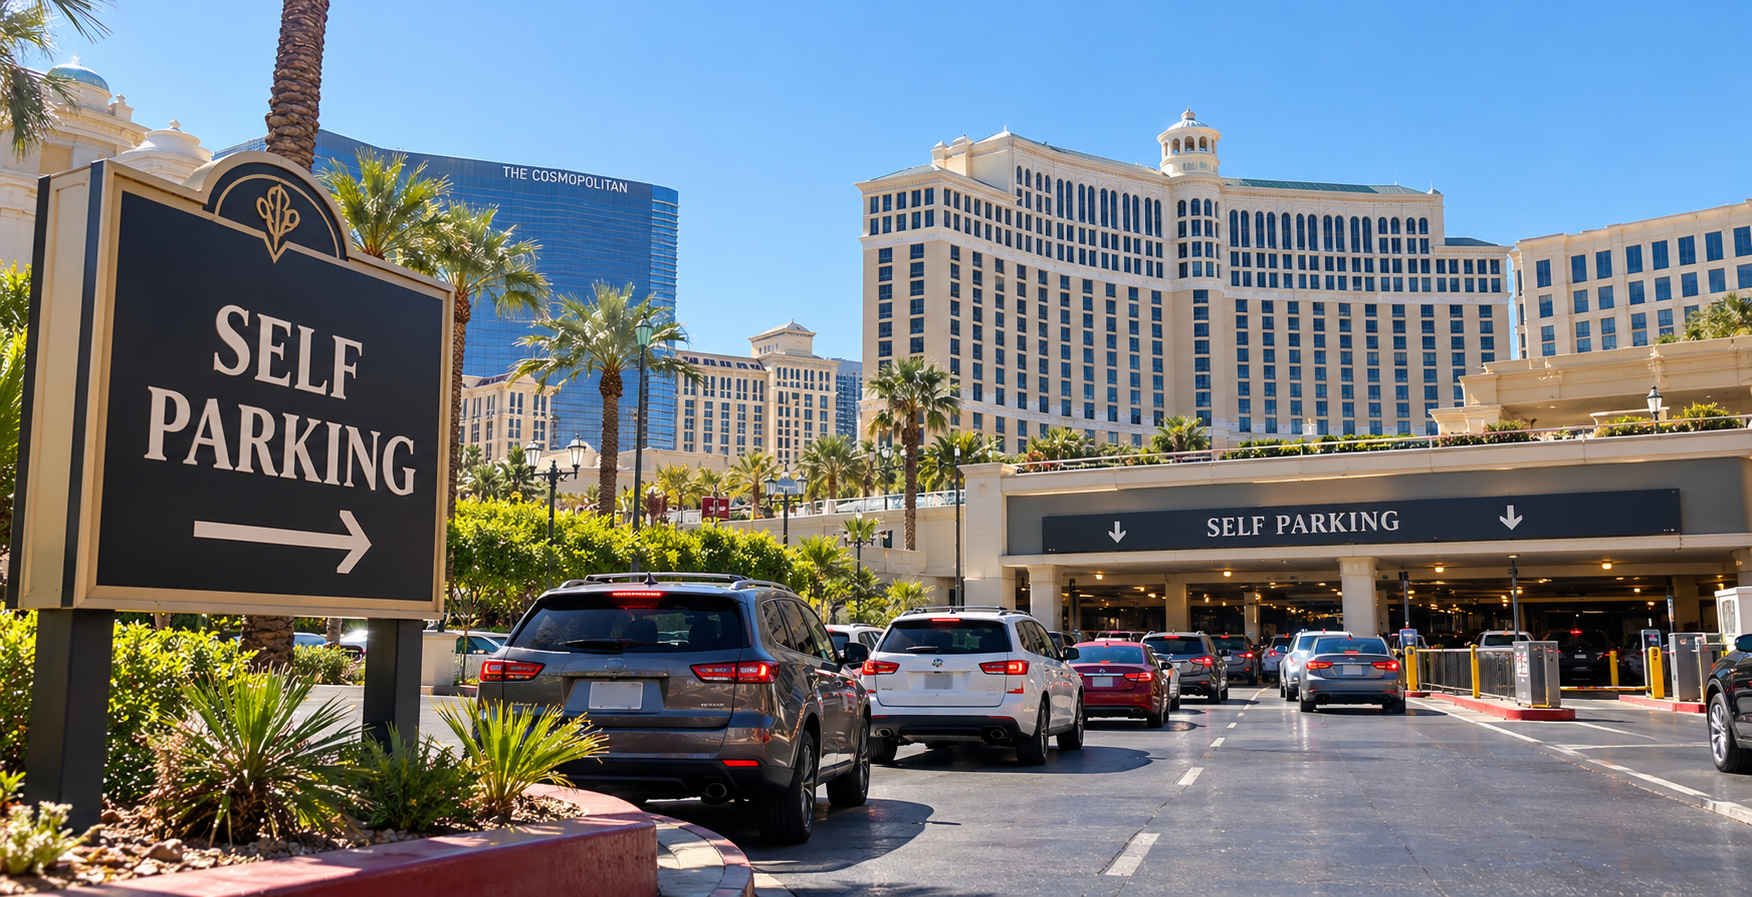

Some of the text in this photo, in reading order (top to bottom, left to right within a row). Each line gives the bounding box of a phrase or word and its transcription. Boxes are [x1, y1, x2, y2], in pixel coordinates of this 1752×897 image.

[502, 165, 628, 194] THE COSMOPOLITAN
[213, 304, 363, 400] SELF
[144, 385, 416, 496] PARKING
[1206, 510, 1400, 538] SELF PARKING
